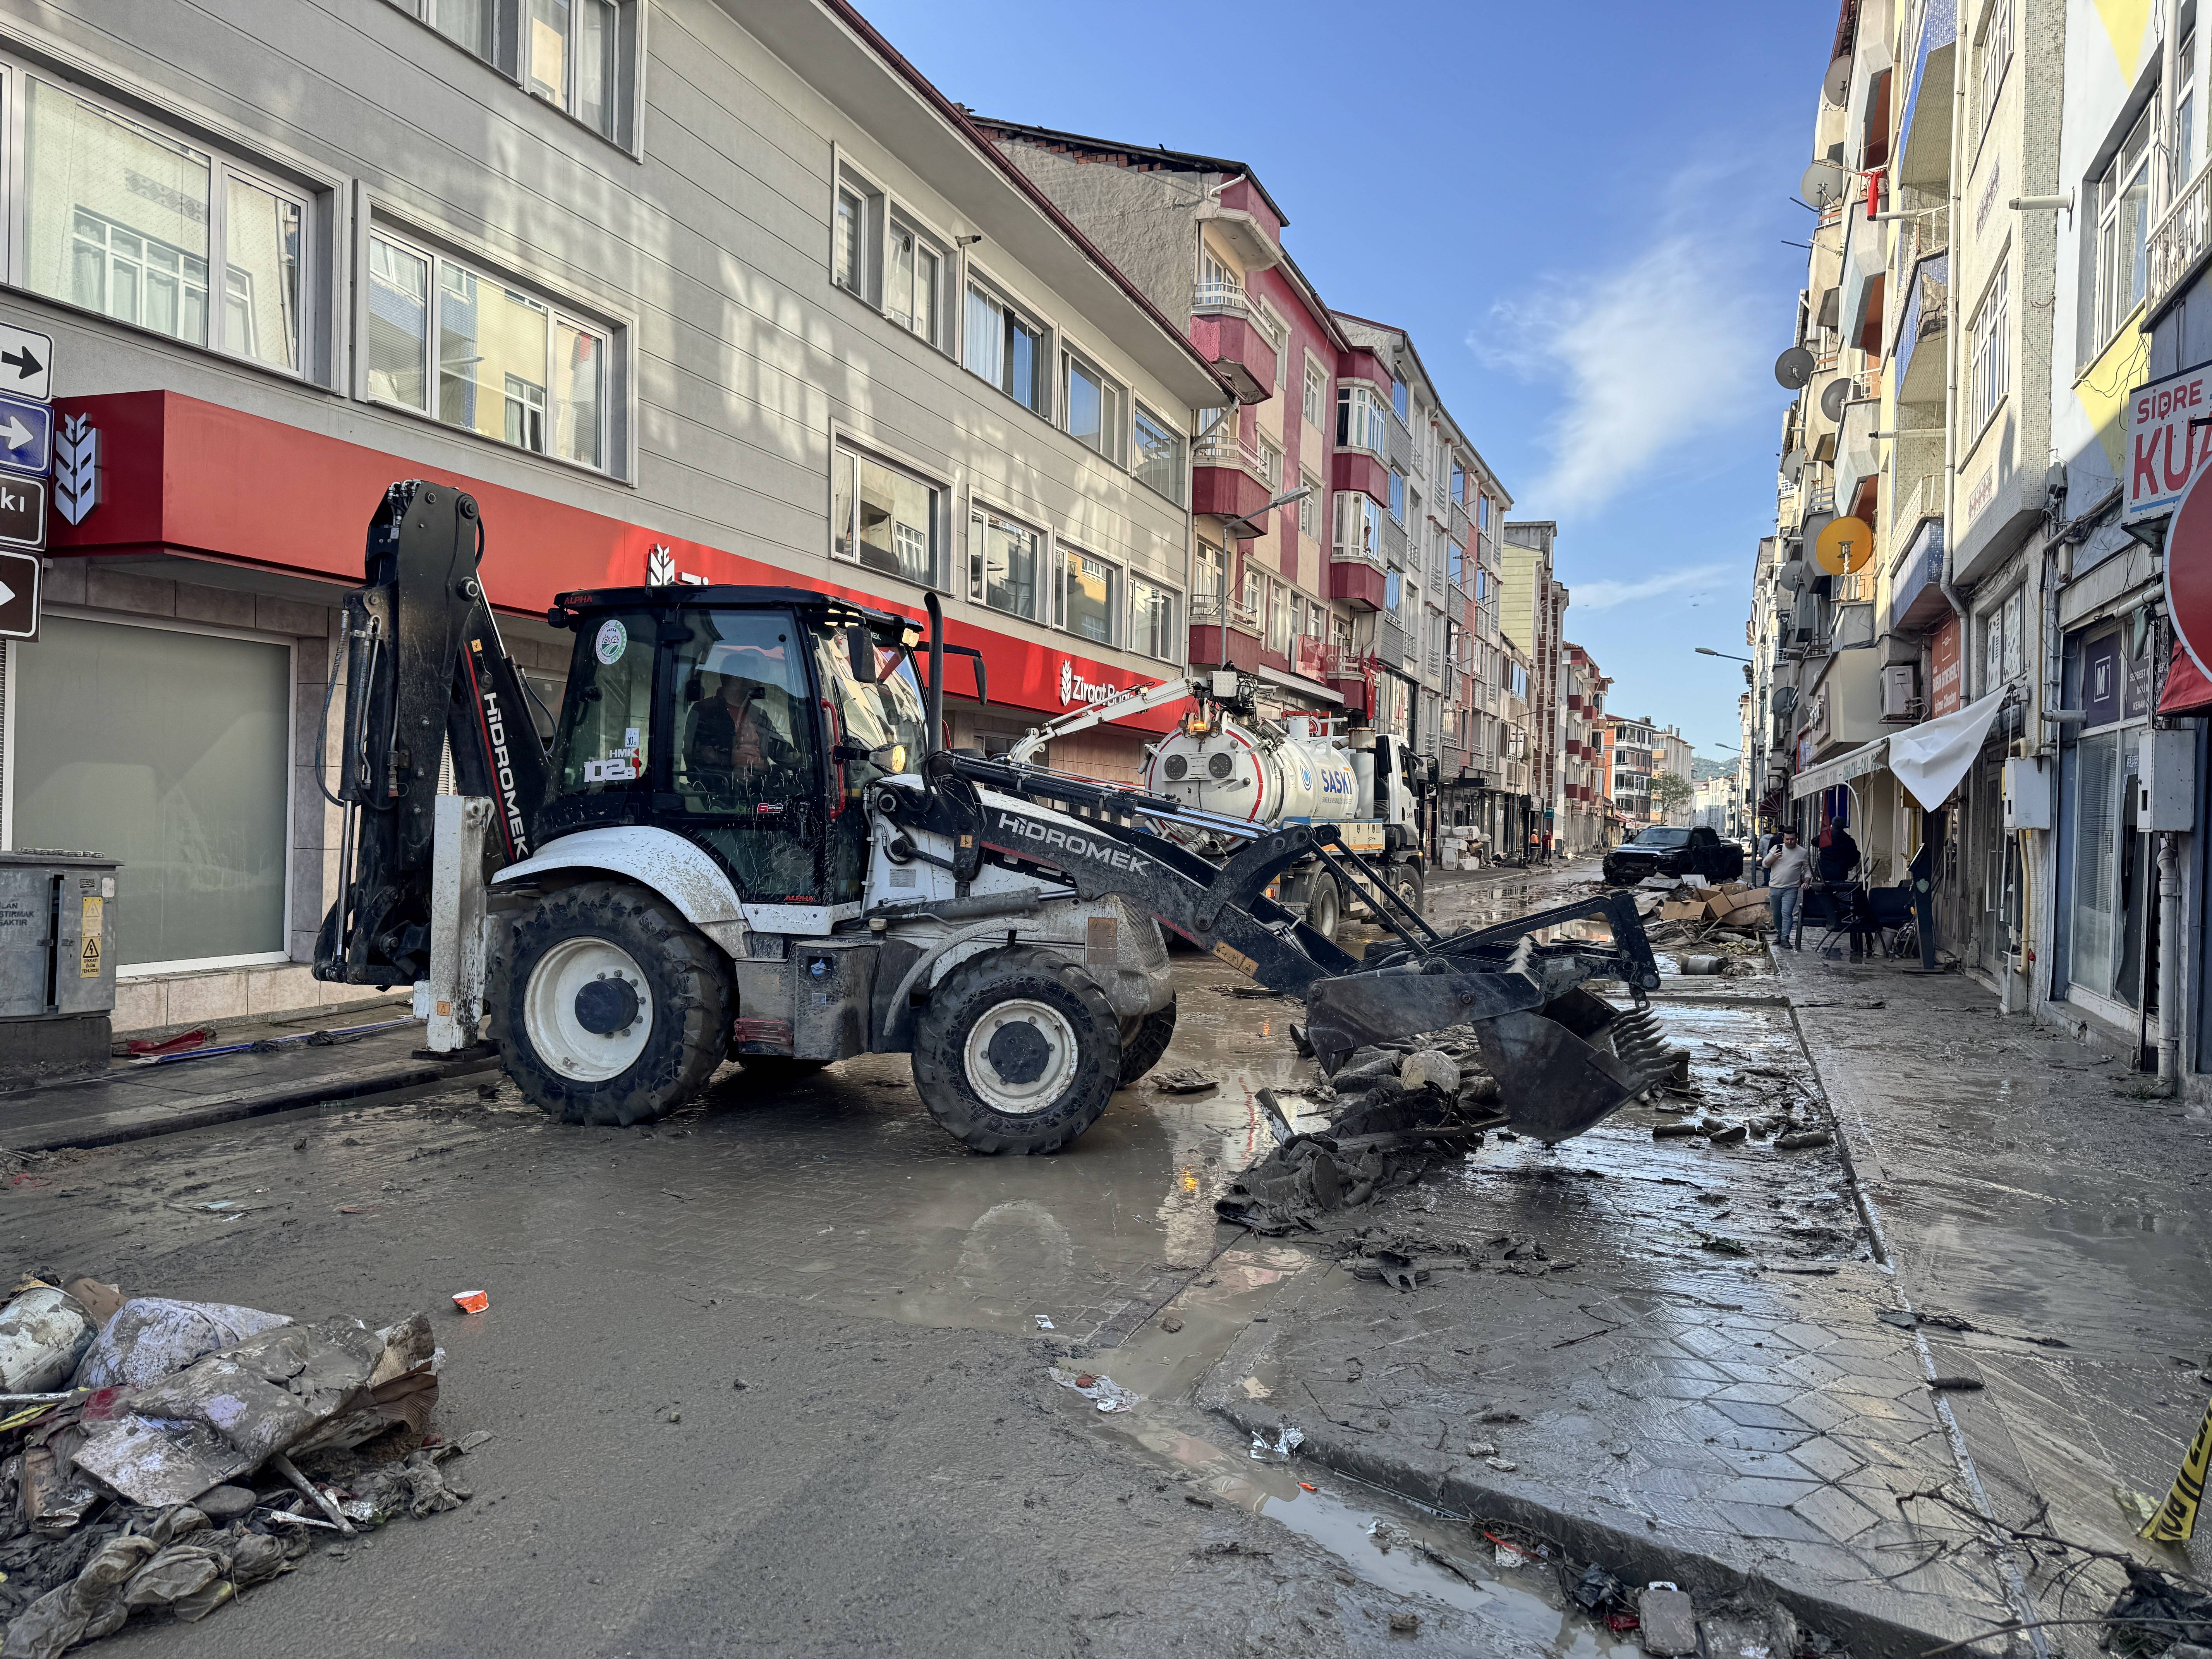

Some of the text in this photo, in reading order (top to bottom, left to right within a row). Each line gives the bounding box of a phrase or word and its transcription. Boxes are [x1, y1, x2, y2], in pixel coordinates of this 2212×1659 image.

[2137, 378, 2203, 424] SİDRE
[564, 595, 592, 605] ALPHA
[2130, 668, 2146, 682] SERBEST
[1072, 675, 1106, 705] Ziraat
[609, 748, 639, 758] HMK
[998, 812, 1152, 878] HİDROMEK
